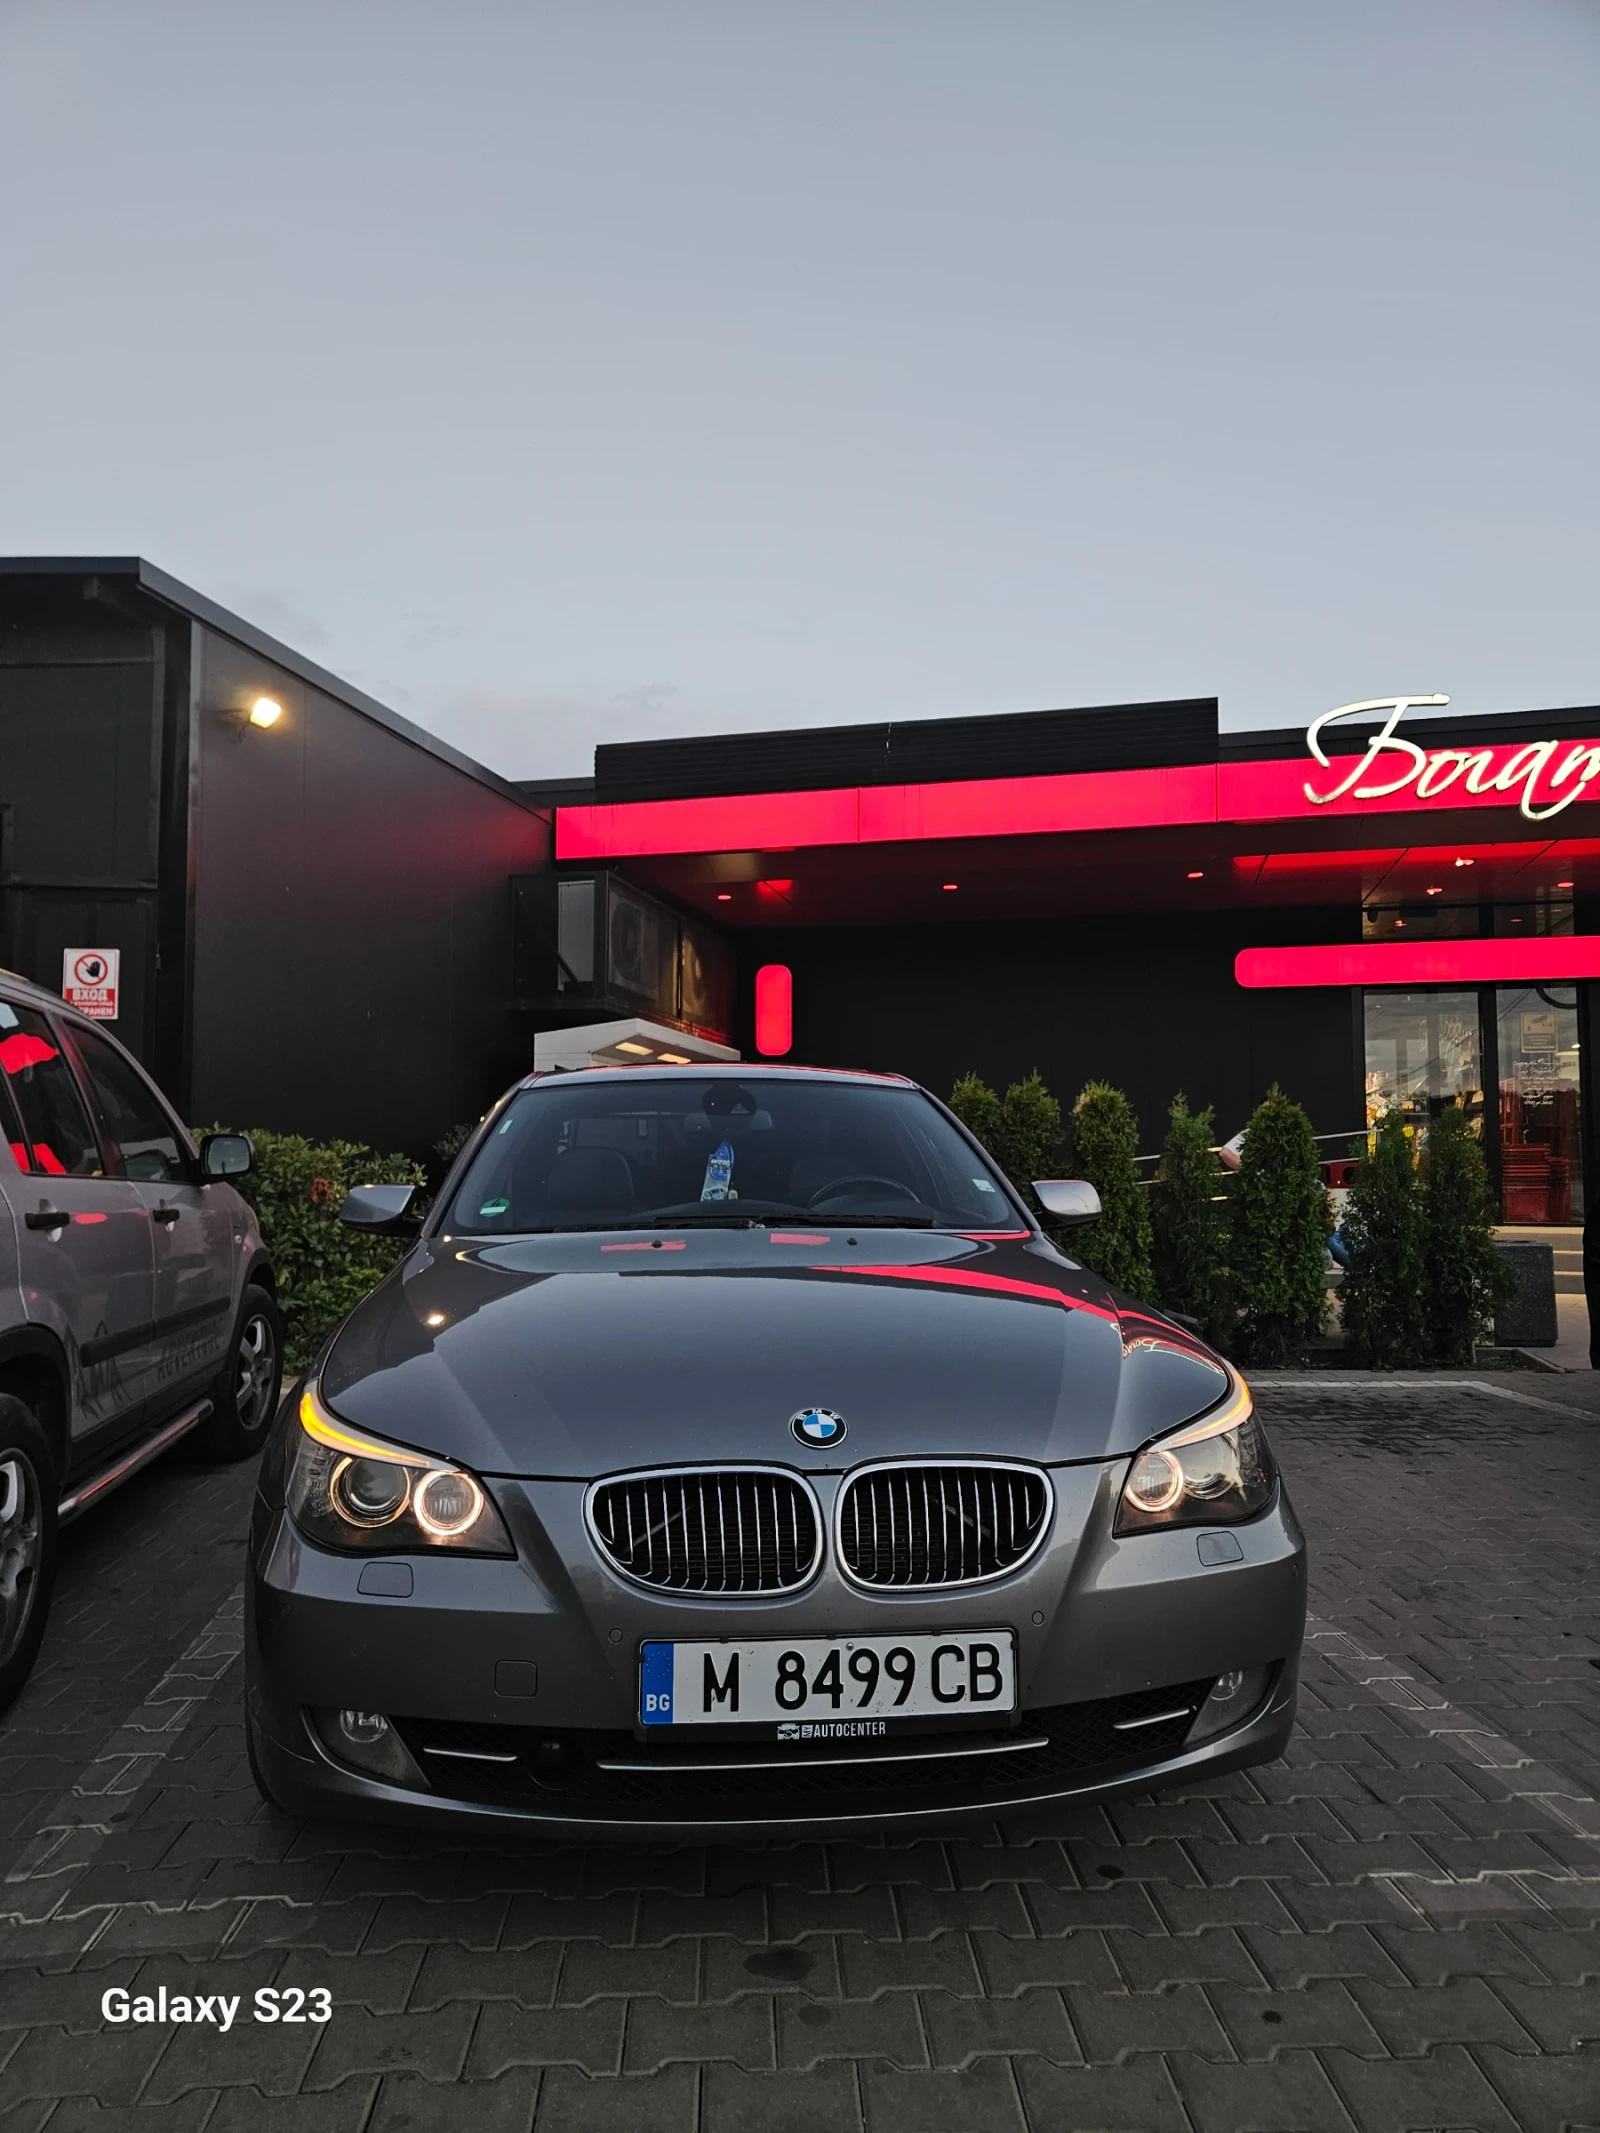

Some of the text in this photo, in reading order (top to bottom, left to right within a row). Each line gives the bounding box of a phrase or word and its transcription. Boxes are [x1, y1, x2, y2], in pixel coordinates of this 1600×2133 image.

[73, 989, 108, 1001] ВХОД
[797, 1408, 840, 1421] BMW
[703, 1641, 1004, 1712] M 8499 CB
[646, 1693, 670, 1712] BG
[814, 1721, 886, 1738] AUTOCENTER
